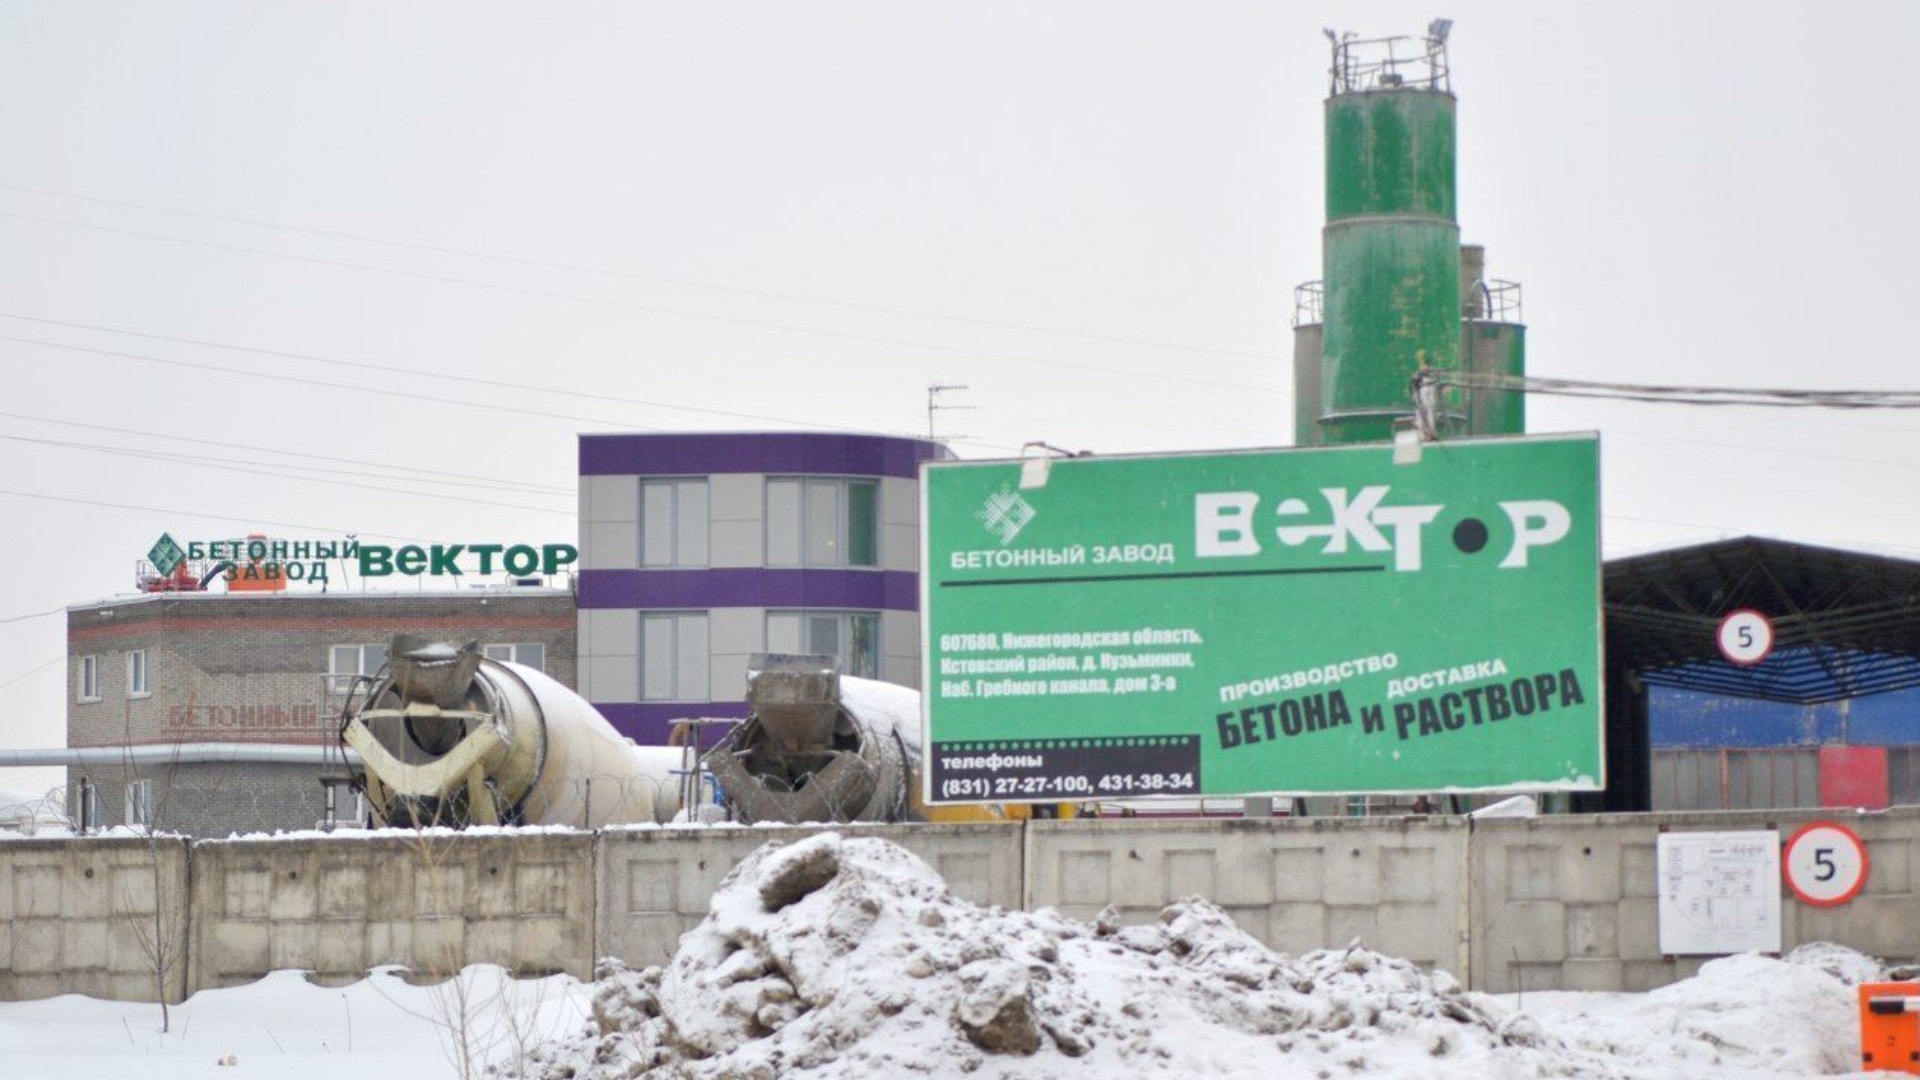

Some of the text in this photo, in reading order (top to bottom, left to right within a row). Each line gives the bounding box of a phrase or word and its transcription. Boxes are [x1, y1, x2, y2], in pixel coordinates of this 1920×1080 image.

[188, 535, 359, 560] БЕТОННЫЙ
[951, 543, 1174, 569] БЕТОННЫЙ ЗАВОД
[222, 561, 328, 584] ЗАВОД
[1002, 630, 1130, 649] Нижегородская
[1132, 628, 1203, 645] область,
[1738, 626, 1753, 647] 5
[940, 656, 1025, 675] Кстовский
[1027, 654, 1079, 673] район,
[1100, 652, 1195, 670] Кузьминки,
[941, 680, 974, 698] Наб.
[976, 678, 1047, 698] Гребного
[1049, 678, 1111, 694] канала,
[1113, 676, 1147, 694] дом
[1219, 652, 1399, 702] ПРОИЗВОДСТВО
[1387, 658, 1507, 699] ДОСТАВКА
[1216, 689, 1352, 749] БЕТОНА
[1394, 667, 1585, 740] РАСТВОРА
[941, 754, 1042, 771] телефоны
[942, 773, 1194, 797] (831) 27-27-100, 431-38-34
[1814, 848, 1836, 881] 5
